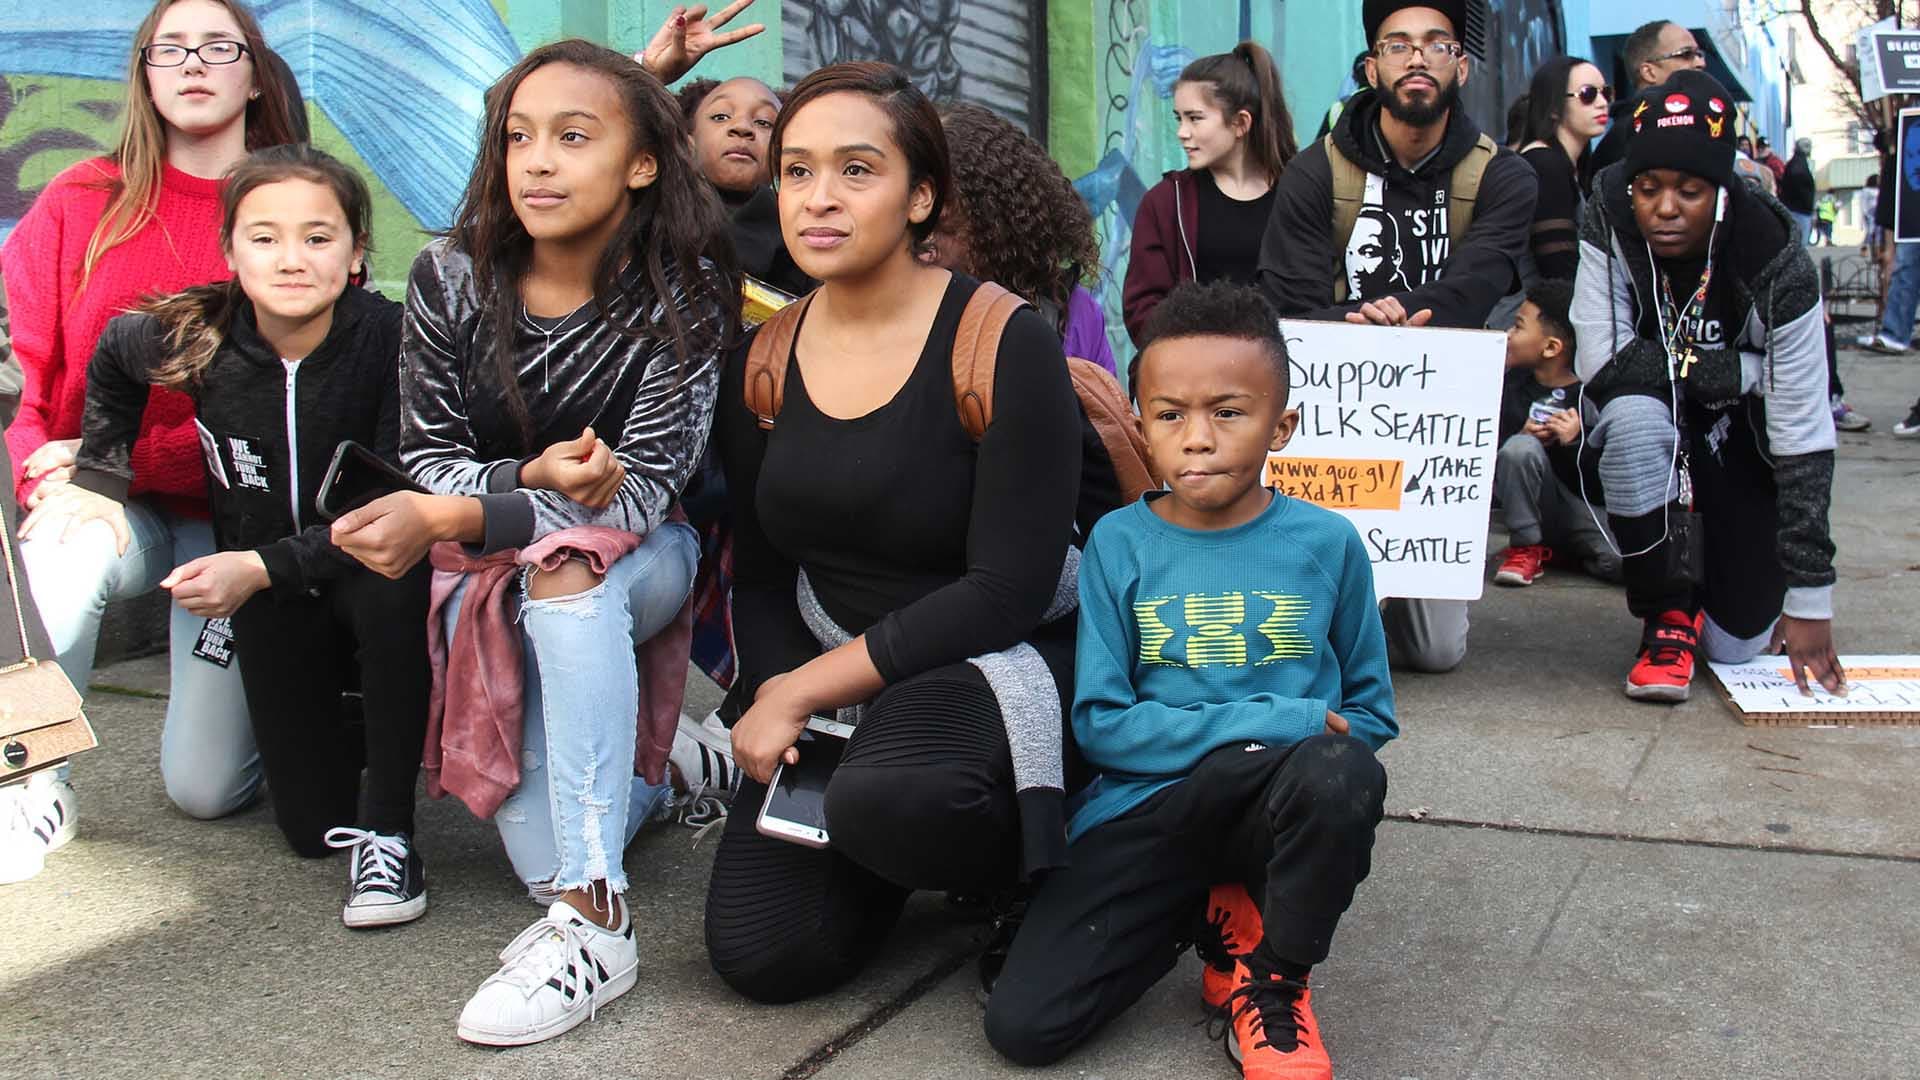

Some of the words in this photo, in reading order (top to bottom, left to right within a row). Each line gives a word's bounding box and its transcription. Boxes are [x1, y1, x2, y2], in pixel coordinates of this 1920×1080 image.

[1886, 40, 1920, 52] BLAC
[1286, 337, 1437, 402] Support
[1371, 404, 1493, 447] SEATTLE
[229, 437, 251, 454] WE
[233, 461, 257, 475] TURN
[1429, 456, 1483, 479] TAKE
[240, 472, 269, 488] BACK
[1420, 486, 1435, 505] A
[1443, 484, 1480, 504] PIC
[1367, 527, 1473, 564] SEATTLE
[201, 630, 226, 647] TURN
[207, 620, 234, 638] CANN
[201, 642, 231, 662] BACK
